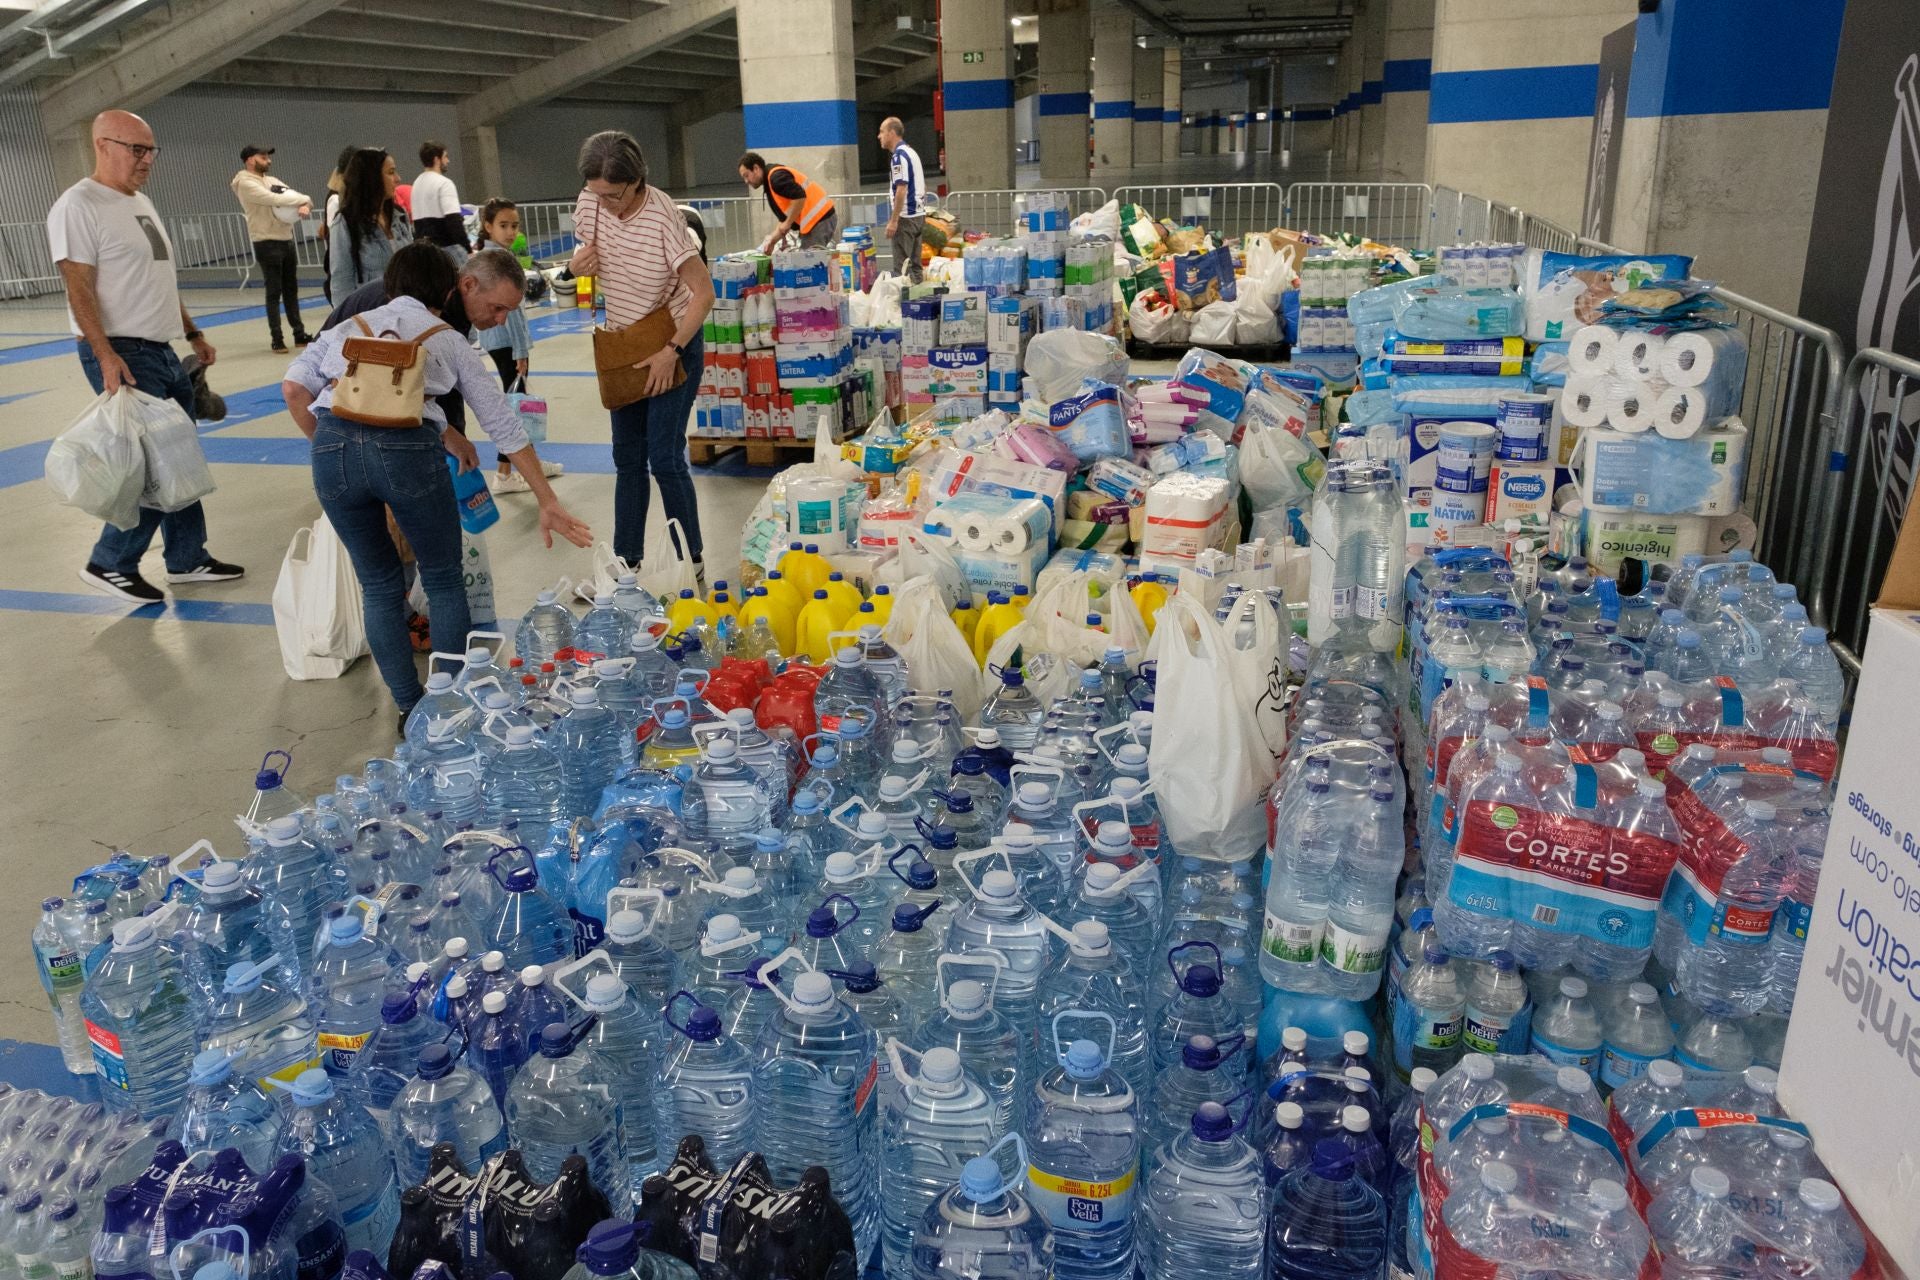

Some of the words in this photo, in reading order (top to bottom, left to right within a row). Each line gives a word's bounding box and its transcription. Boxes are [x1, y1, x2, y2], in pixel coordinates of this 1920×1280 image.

[935, 351, 978, 362] PULEVA
[780, 367, 806, 376] ENTERA
[949, 370, 976, 379] Peques
[977, 369, 985, 379] 3
[1053, 404, 1082, 424] PANTS
[1508, 480, 1542, 493] Nestlé
[1434, 506, 1476, 521] NATIVA
[1601, 540, 1671, 558] higiénico
[1848, 792, 1893, 838] storage
[1505, 831, 1631, 875] CORTES
[1529, 858, 1541, 866] DE
[1546, 862, 1593, 880] ARENOSO
[1850, 835, 1920, 914] elo.com
[1727, 915, 1770, 928] CORTES
[1696, 1112, 1757, 1122] CORTES
[665, 1165, 802, 1219] INSLUS
[1089, 1183, 1113, 1198] 6.25L
[469, 1198, 479, 1225] INSALUS
[1071, 1198, 1100, 1213] Font
[1070, 1208, 1100, 1222] Vella
[469, 1230, 478, 1258] INSALUS
